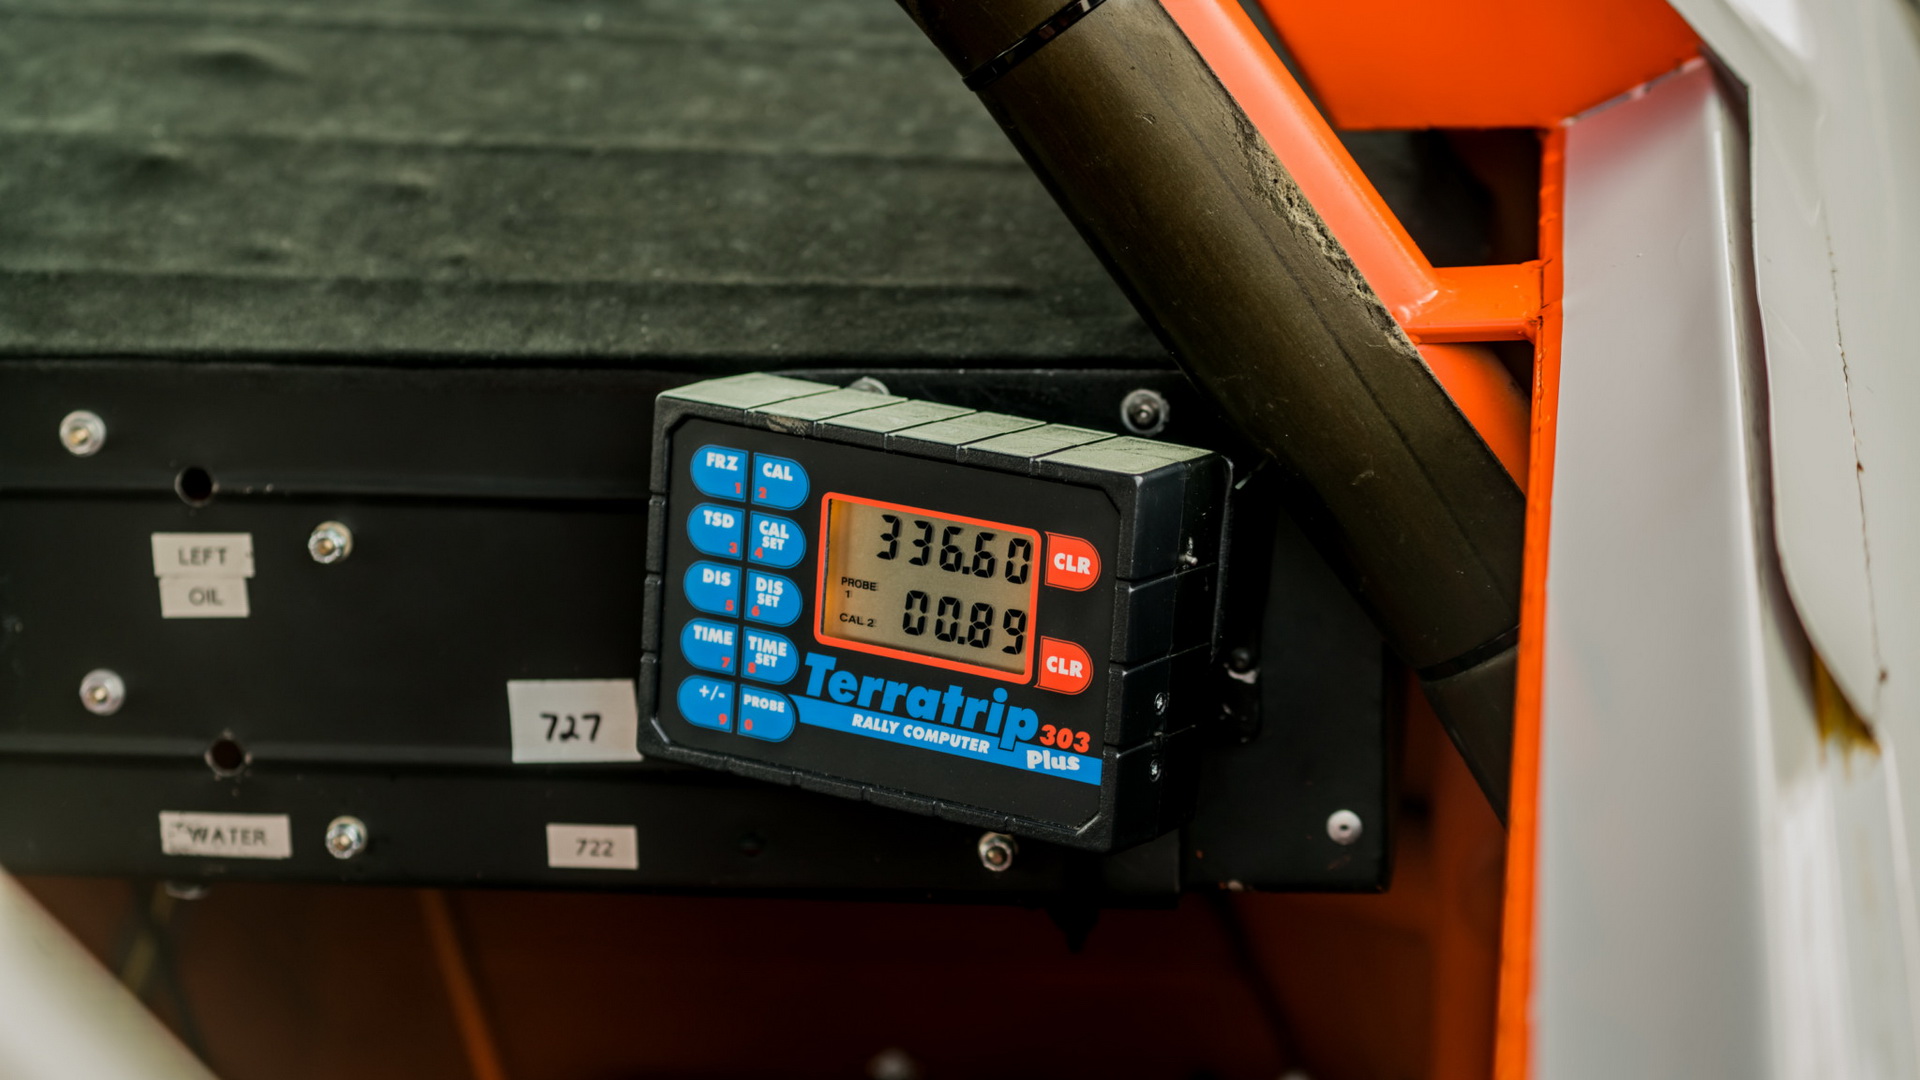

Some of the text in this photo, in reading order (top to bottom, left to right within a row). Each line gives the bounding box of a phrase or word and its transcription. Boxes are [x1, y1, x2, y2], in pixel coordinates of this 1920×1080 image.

[706, 452, 738, 471] FRZ
[762, 462, 793, 481] CAL
[735, 482, 741, 494] 1
[758, 487, 767, 499] 2
[703, 510, 735, 528] TSD
[759, 520, 789, 539] CAL
[729, 542, 737, 554] 3
[754, 547, 764, 559] 4
[762, 536, 785, 551] SET
[876, 514, 1031, 585] 336.60
[178, 546, 226, 566] LEFT
[1053, 552, 1091, 575] CLR
[702, 568, 731, 587] DIS
[755, 577, 783, 596] DIS
[841, 576, 877, 592] PROBE
[188, 586, 223, 607] OIL
[757, 593, 780, 608] SET
[845, 590, 851, 599] 1
[725, 600, 734, 612] 5
[751, 605, 760, 617] 6
[839, 612, 875, 628] CAL 2
[902, 590, 1027, 655] 00.89
[693, 625, 733, 646] TIME
[748, 635, 787, 657] TIME
[721, 656, 731, 668] 7
[747, 662, 756, 674] 8
[755, 652, 778, 668] SET
[1046, 655, 1084, 679] CLR
[743, 694, 785, 713] PROBE
[804, 652, 1091, 753] Terratrip 303
[540, 712, 602, 743] 727
[718, 713, 727, 725] 9
[744, 719, 753, 731] 0
[851, 713, 991, 755] RALLY COMPUTER
[1026, 749, 1081, 771] Plus
[188, 826, 267, 846] WATER
[576, 838, 615, 858] 722
